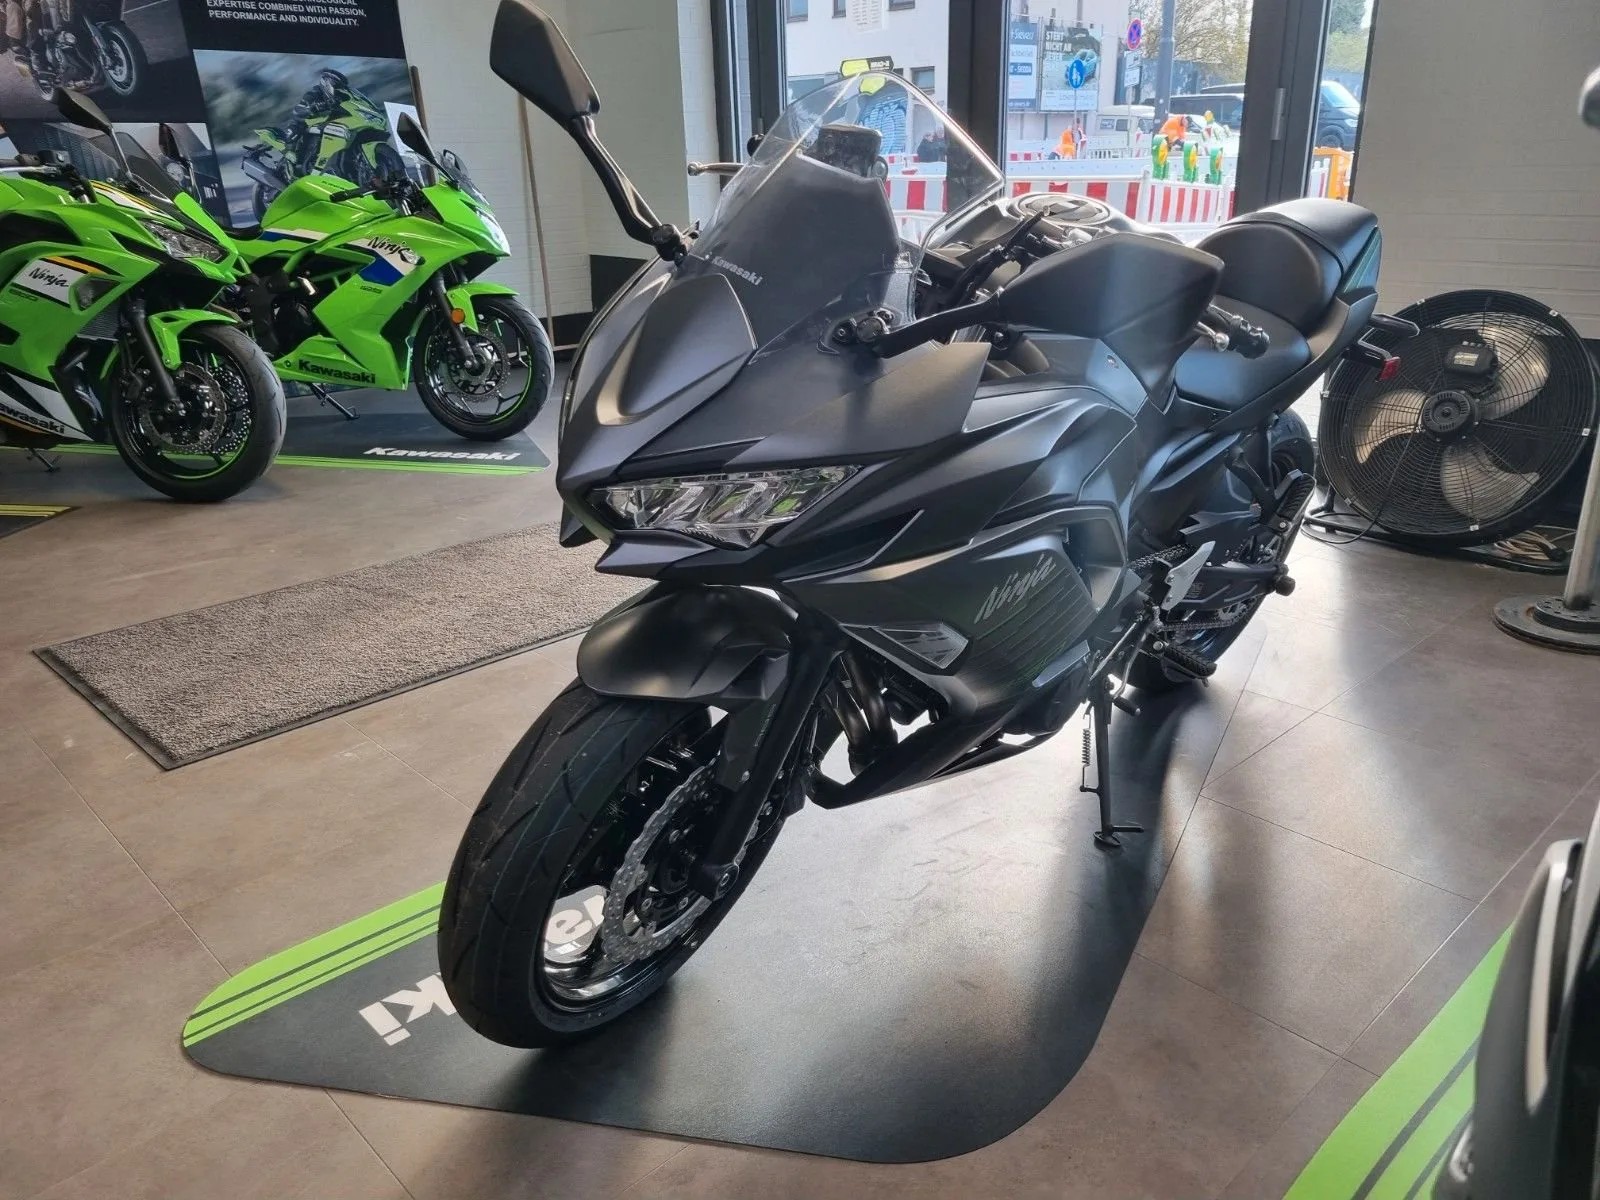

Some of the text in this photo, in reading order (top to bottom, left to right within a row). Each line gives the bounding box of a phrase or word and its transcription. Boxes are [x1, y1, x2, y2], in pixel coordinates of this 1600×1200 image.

[207, 0, 367, 17] EXPERTISE COMBINED WITH PASSION,
[208, 9, 359, 26] PERFORMANCE AND INDIVIDUALITY.
[29, 267, 69, 287] Ninja
[711, 256, 763, 286] Kawasaki
[298, 359, 376, 384] Kawasaki
[0, 403, 65, 434] awasaki
[363, 447, 521, 461] Kawasaki
[973, 552, 1057, 624] Ninja
